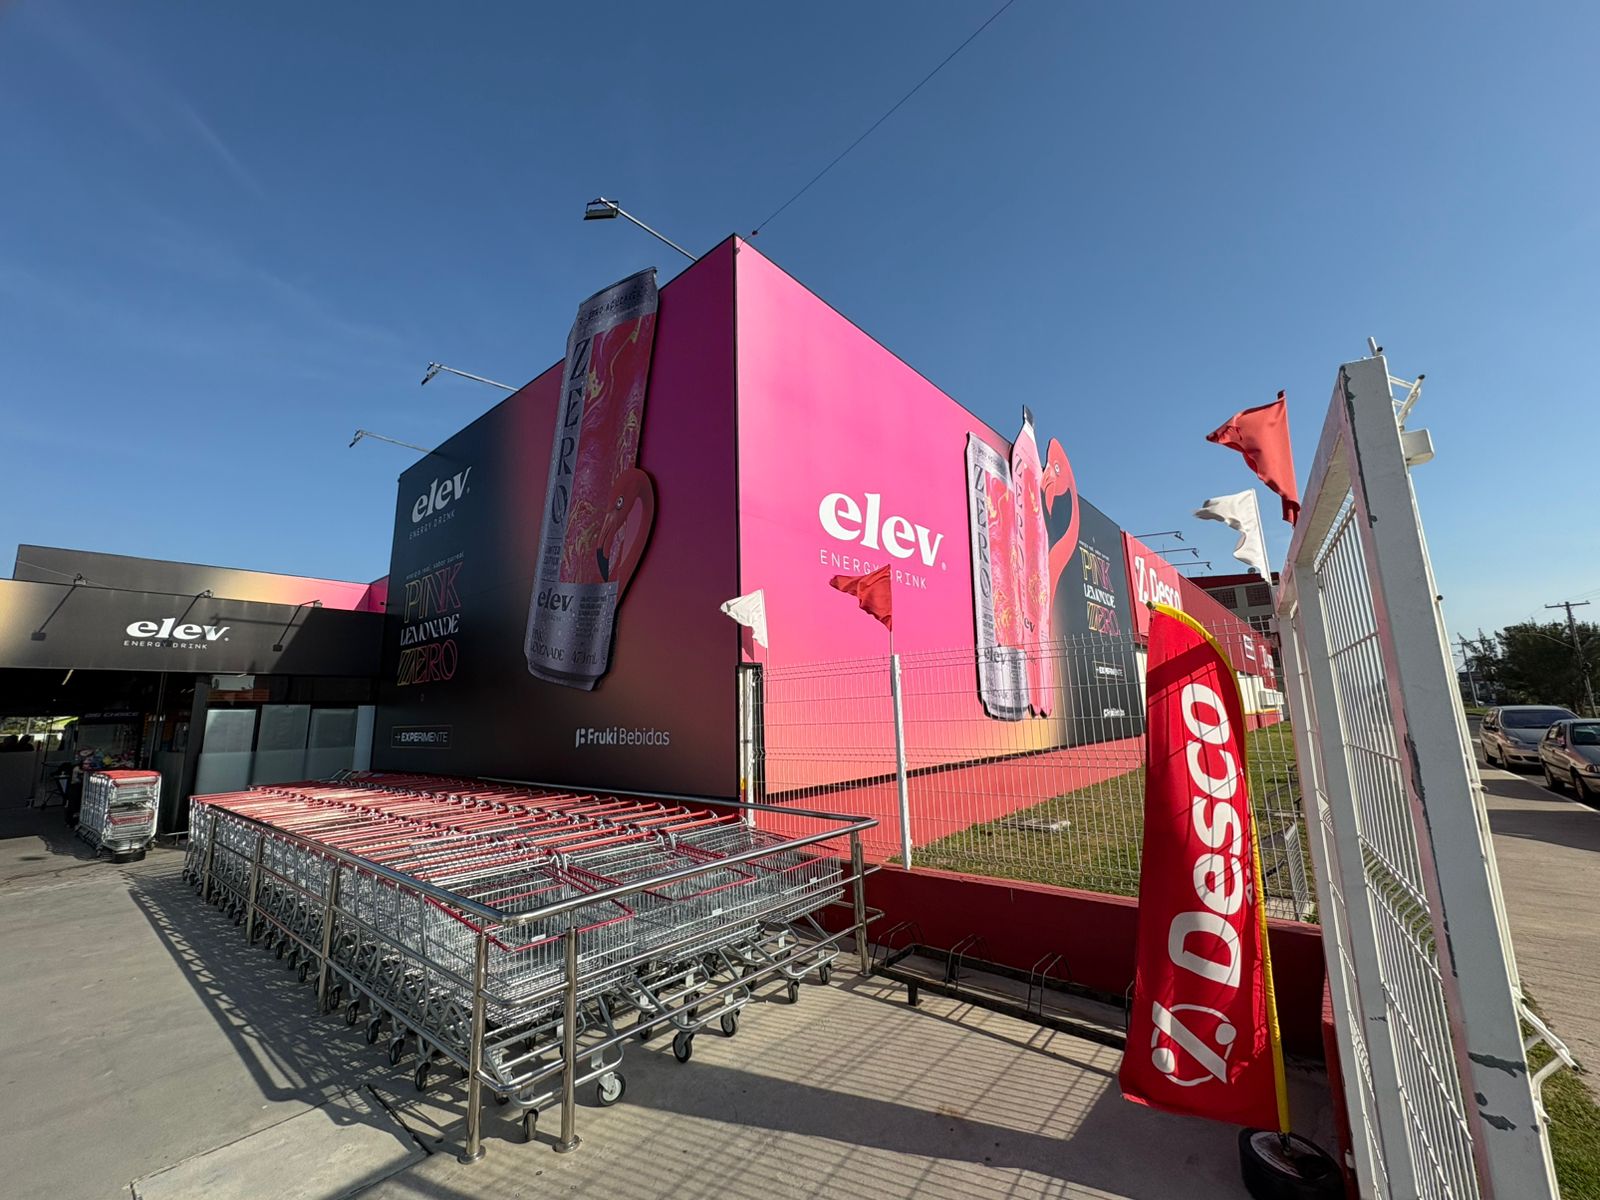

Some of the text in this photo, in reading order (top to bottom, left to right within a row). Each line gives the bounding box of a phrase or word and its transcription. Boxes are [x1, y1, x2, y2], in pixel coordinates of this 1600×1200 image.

[552, 338, 591, 526] ZERO
[412, 466, 472, 523] elev
[818, 492, 945, 567] elev
[974, 464, 991, 598] ZERO
[404, 561, 463, 623] PINK
[889, 568, 927, 590] RINK
[1078, 546, 1115, 593] PINK
[1149, 567, 1181, 611] Desco
[537, 588, 574, 612] elev
[123, 640, 208, 650] ENERGY DRINK
[126, 617, 230, 641] elev
[400, 613, 461, 646] LEMONADE
[397, 639, 459, 686] ZERO
[586, 727, 670, 746] Fruki Bebidas
[1168, 683, 1244, 988] Desco
